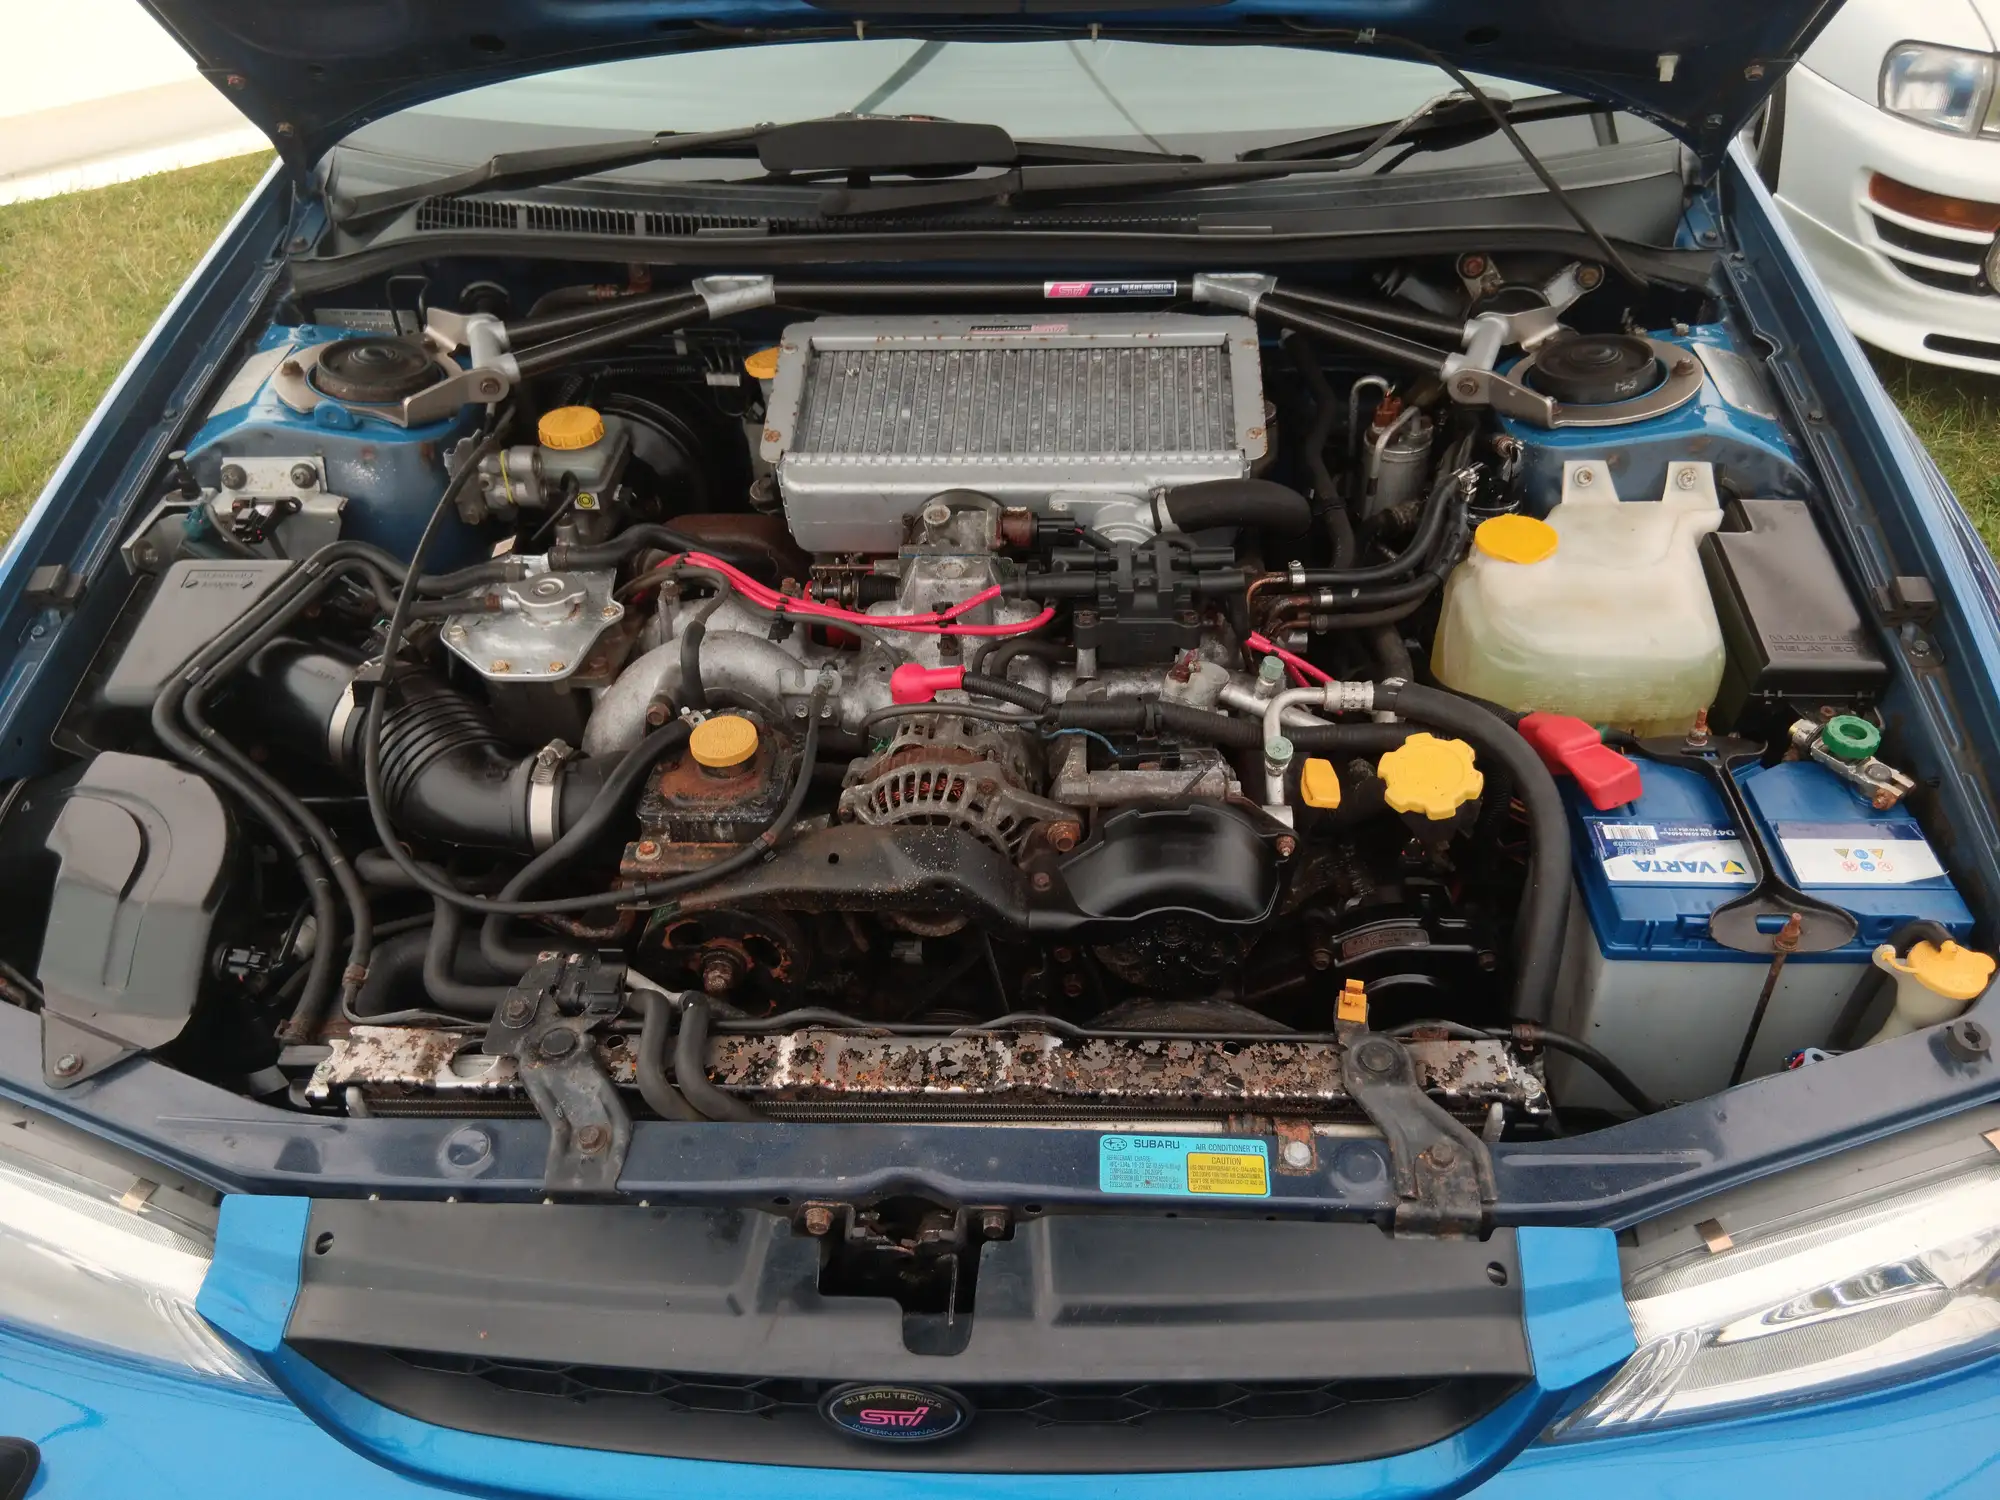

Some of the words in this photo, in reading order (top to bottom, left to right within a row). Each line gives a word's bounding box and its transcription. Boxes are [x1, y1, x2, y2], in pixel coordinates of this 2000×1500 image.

[1769, 634, 1814, 642] MAIN
[1618, 846, 1656, 856] BLUE
[1633, 860, 1718, 874] VARTA
[1134, 1139, 1180, 1150] SUBARU
[1208, 1144, 1252, 1152] CONDITIONER
[1212, 1156, 1242, 1165] CAUTION
[844, 1392, 891, 1406] SUBARU
[894, 1392, 942, 1409] TECNICA
[852, 1423, 940, 1437] INTERNATIONAL
